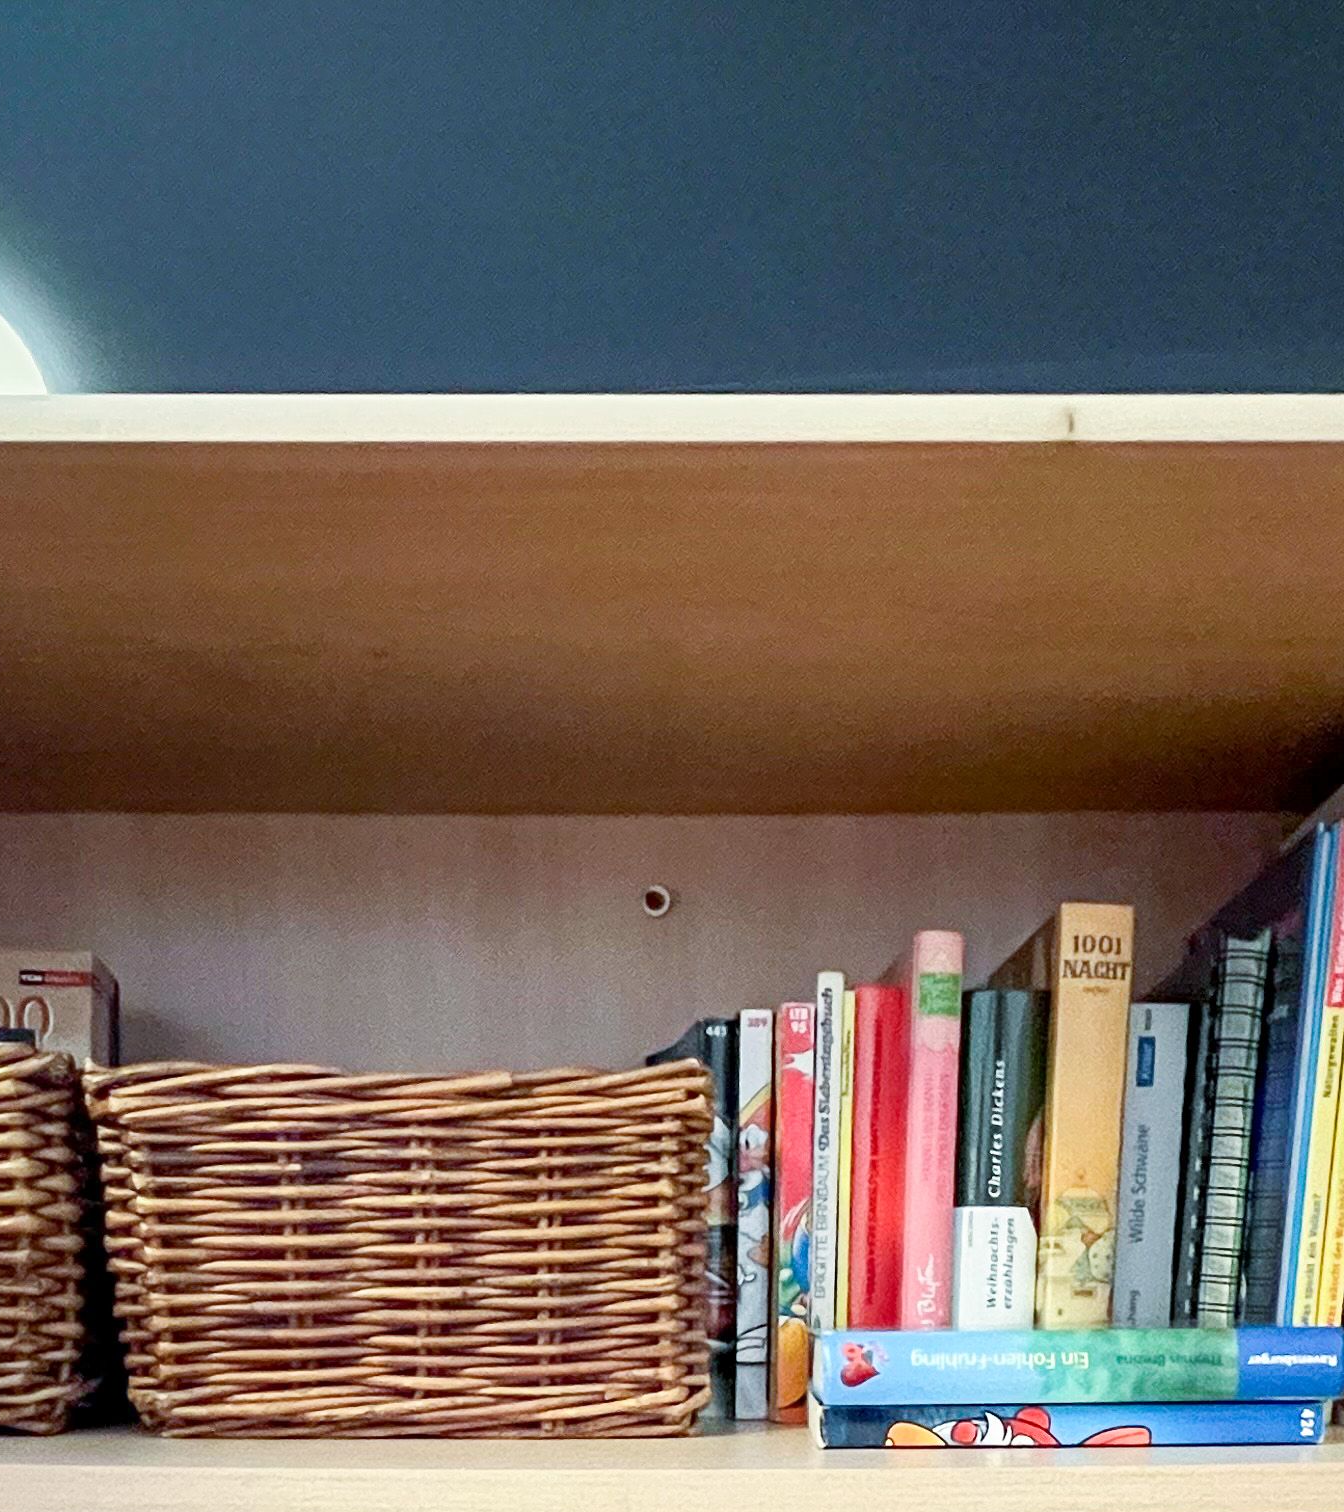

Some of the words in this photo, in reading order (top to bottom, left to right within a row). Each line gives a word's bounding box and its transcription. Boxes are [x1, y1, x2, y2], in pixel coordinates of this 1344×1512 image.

[1071, 934, 1122, 956] 1001
[1061, 958, 1131, 982] NACHT
[1321, 1013, 1340, 1099] Naturgewalten
[991, 1059, 1006, 1121] Dickens
[819, 1116, 832, 1151] Das
[987, 1122, 1003, 1199] Charles
[816, 1155, 831, 1233] BIRNBAUM
[1128, 1199, 1145, 1244] Wilde
[813, 1237, 829, 1298] BRIGITTE
[910, 1347, 1056, 1371] Fohlen-Frühling
[1059, 1351, 1091, 1369] Ein
[1247, 1352, 1338, 1368] Ravensburger
[1299, 1407, 1315, 1438] 424
